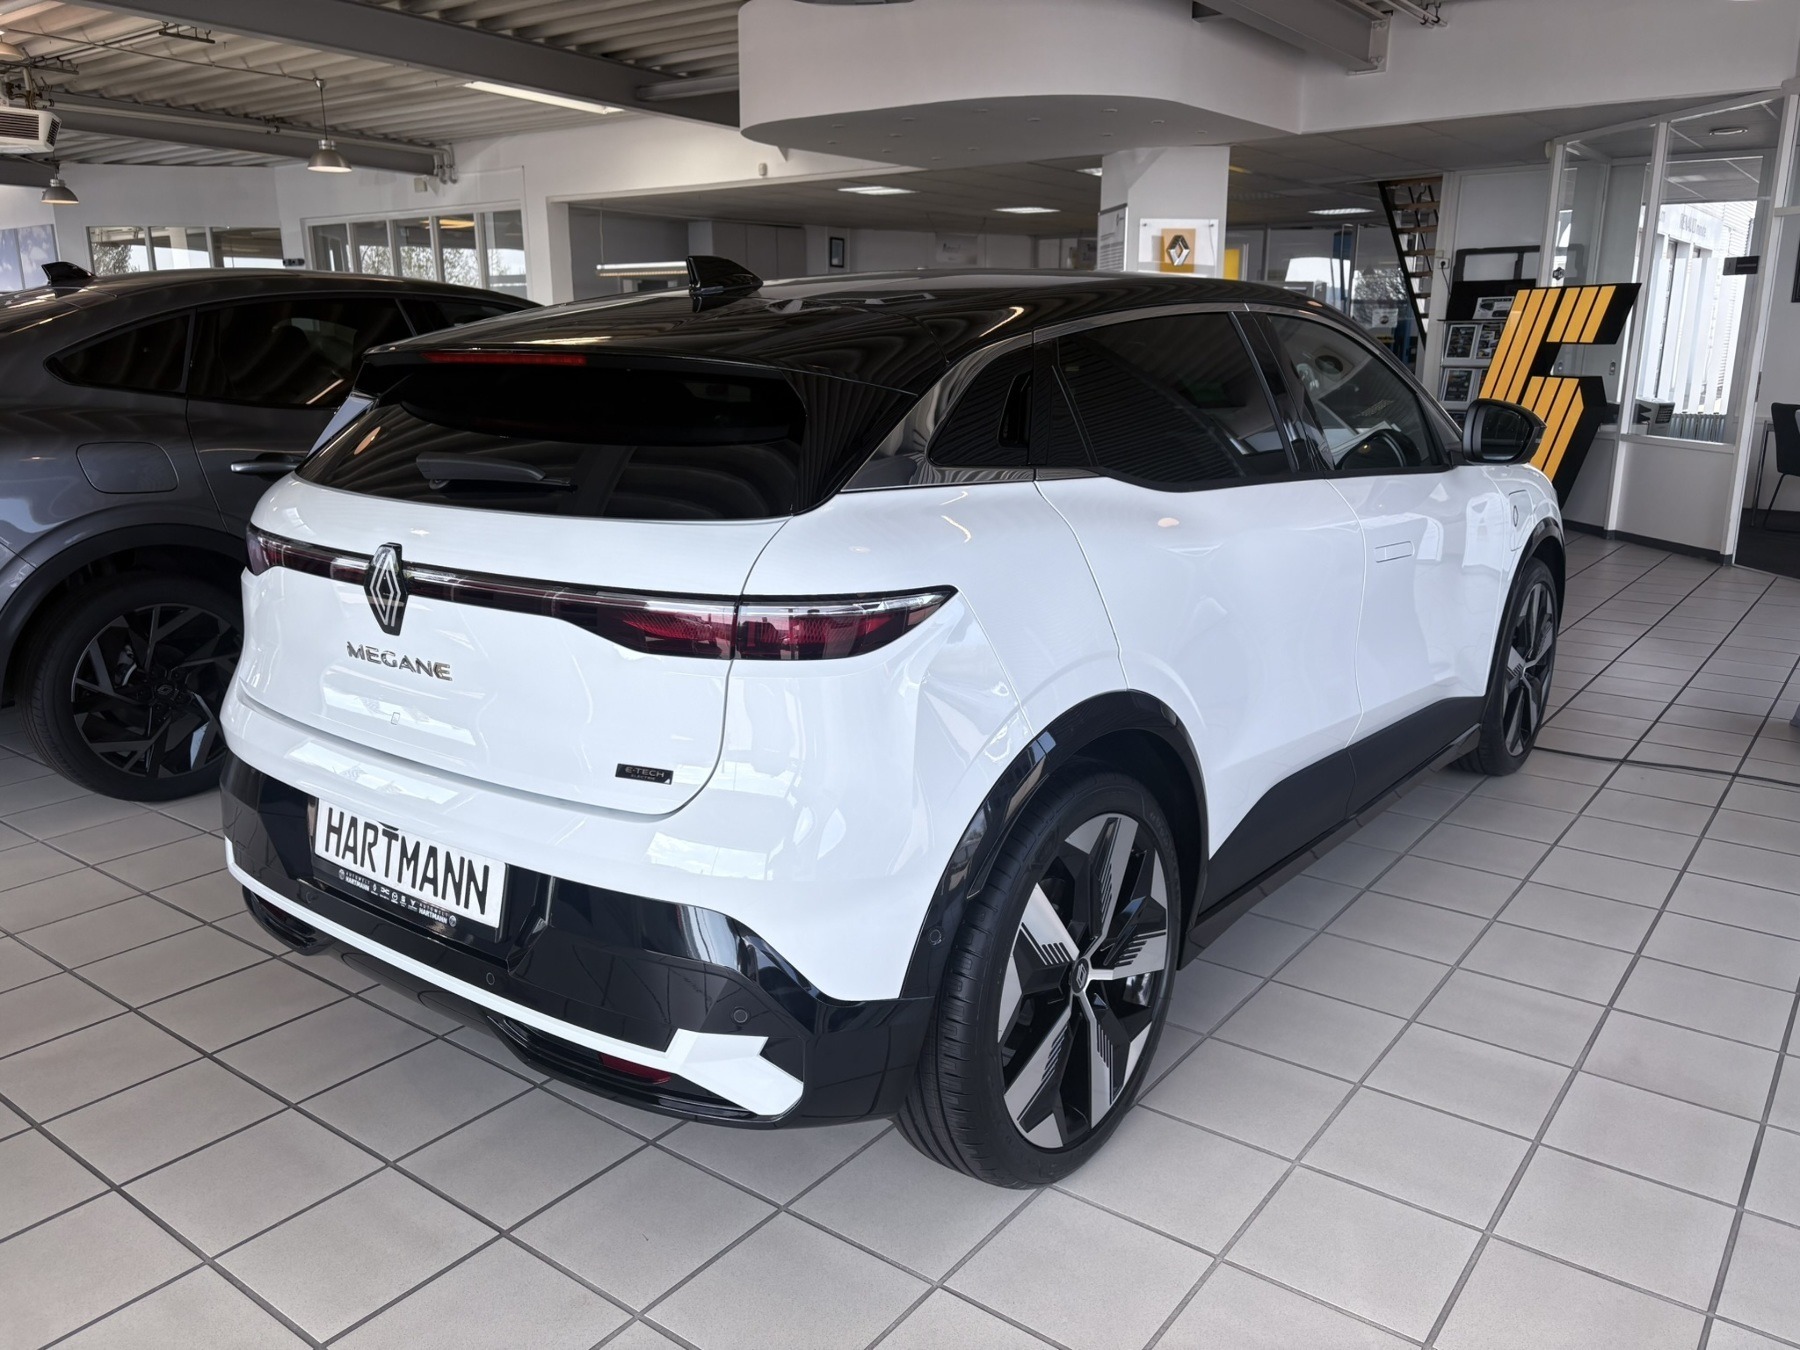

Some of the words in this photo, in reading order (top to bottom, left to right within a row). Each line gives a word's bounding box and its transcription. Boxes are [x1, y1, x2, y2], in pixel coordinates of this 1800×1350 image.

[346, 641, 453, 681] MEGANE
[625, 766, 665, 778] E-TECH
[324, 807, 490, 915] HARTMANN
[418, 907, 448, 925] HARTMANN
